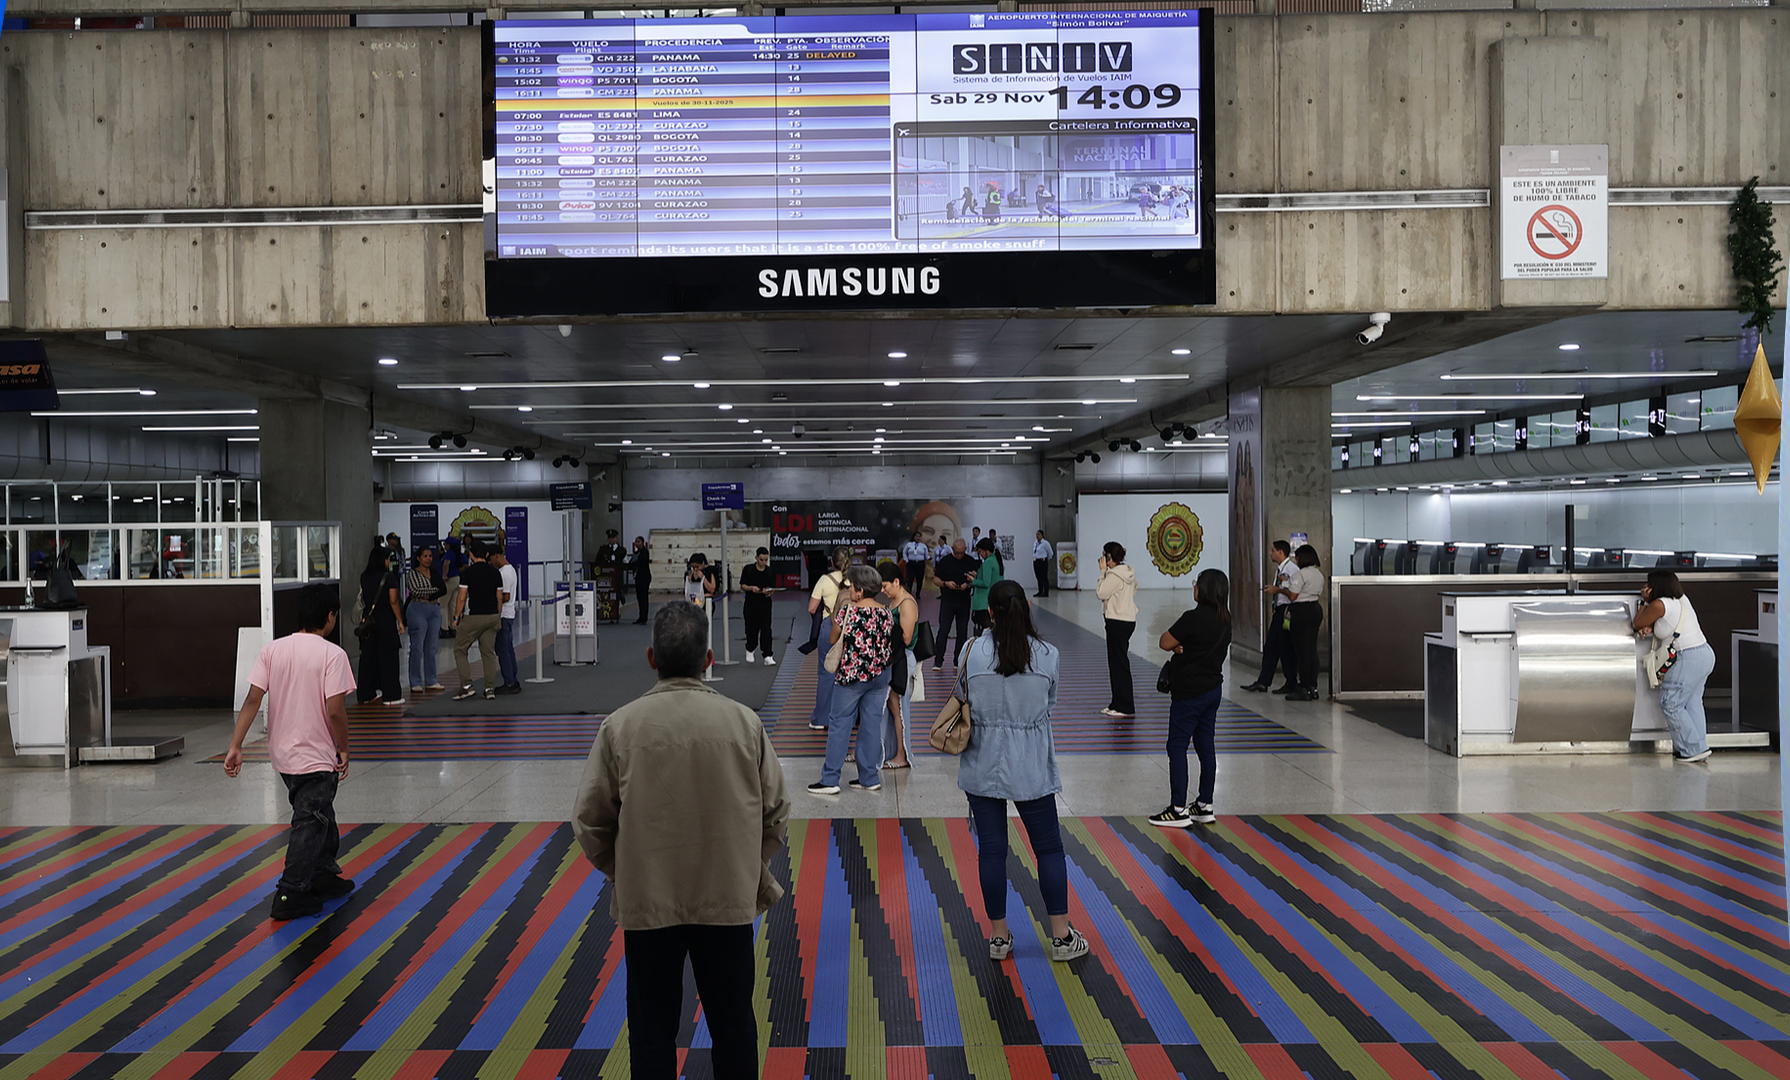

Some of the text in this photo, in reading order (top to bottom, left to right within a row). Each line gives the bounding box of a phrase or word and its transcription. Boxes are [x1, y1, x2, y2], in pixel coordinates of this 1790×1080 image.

[957, 44, 1130, 73] SINIV
[953, 73, 1132, 84] Sistema de Información de Vuelos IAIM
[930, 83, 1181, 110] Sab 29 Nov 14:09
[514, 112, 542, 120] 07:00
[598, 123, 613, 131] QL
[1049, 120, 1191, 131] Cartelera Informativa
[598, 134, 614, 142] QL
[1074, 146, 1146, 155] TERMINAL
[1073, 153, 1147, 162] NACIONAL
[1557, 179, 1597, 187] AMBIENTE
[1526, 194, 1550, 202] HUMO
[516, 202, 544, 210] 18:30
[599, 213, 615, 221] QL
[1126, 214, 1171, 222] Nacional
[520, 247, 547, 255] IAIM
[603, 245, 664, 255] reminds
[667, 244, 687, 254] its
[690, 245, 731, 254] users
[735, 244, 768, 253] that
[771, 243, 784, 252] it
[787, 243, 800, 252] is
[816, 243, 845, 252] site
[849, 242, 891, 251] 100%
[894, 240, 928, 251] free
[931, 240, 949, 250] of
[952, 239, 1001, 250] smoke
[1005, 239, 1047, 249] snuff
[758, 266, 940, 298] SAMSUNG
[773, 514, 813, 533] LDI
[773, 533, 801, 548] todos
[832, 537, 851, 545] más
